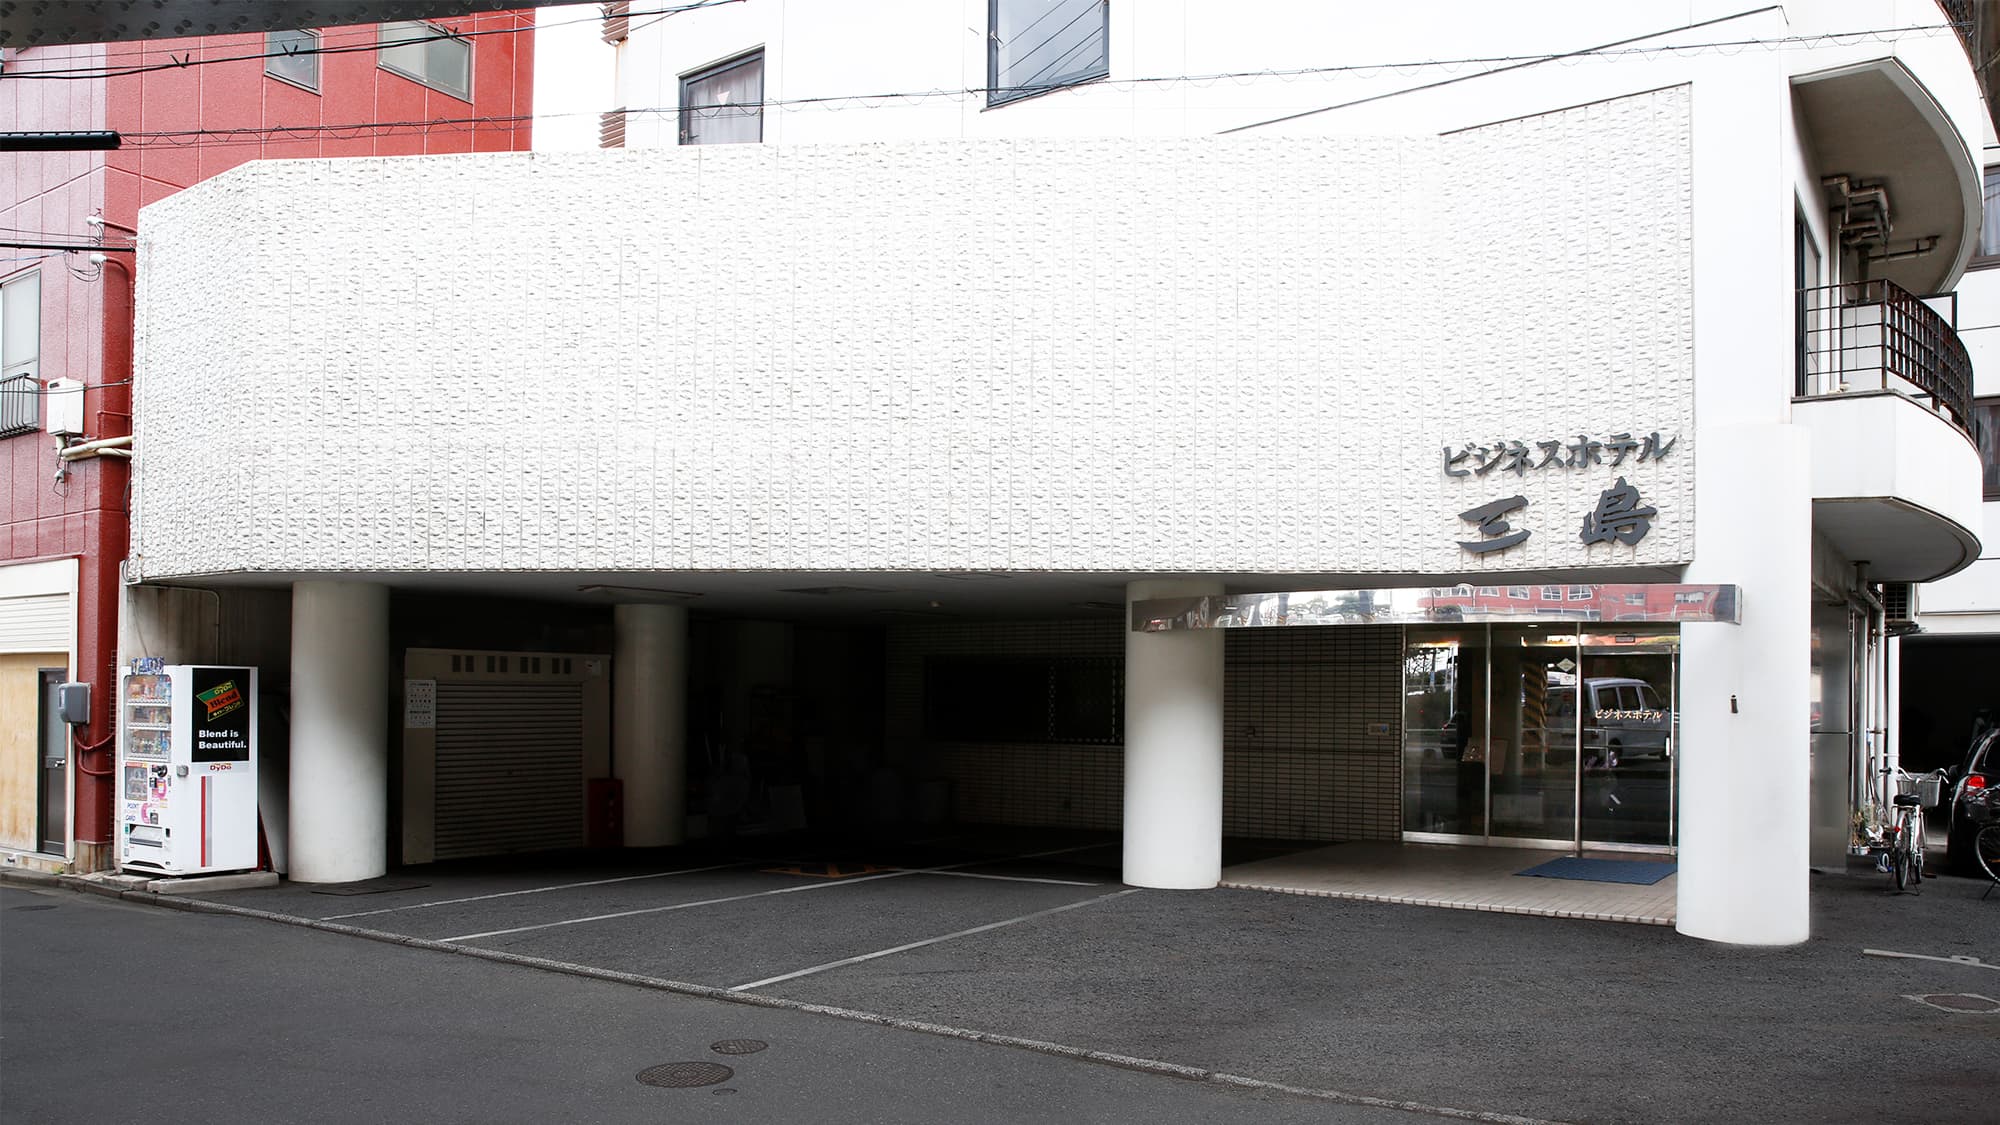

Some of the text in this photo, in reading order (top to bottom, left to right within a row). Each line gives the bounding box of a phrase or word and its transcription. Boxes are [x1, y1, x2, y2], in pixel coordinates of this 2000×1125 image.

[1442, 431, 1679, 478] ビジネスホテル
[1456, 476, 1658, 553] 三島
[1595, 708, 1663, 720] ビジネスホテル
[199, 730, 239, 738] Blend is
[199, 740, 247, 749] Beautiful.
